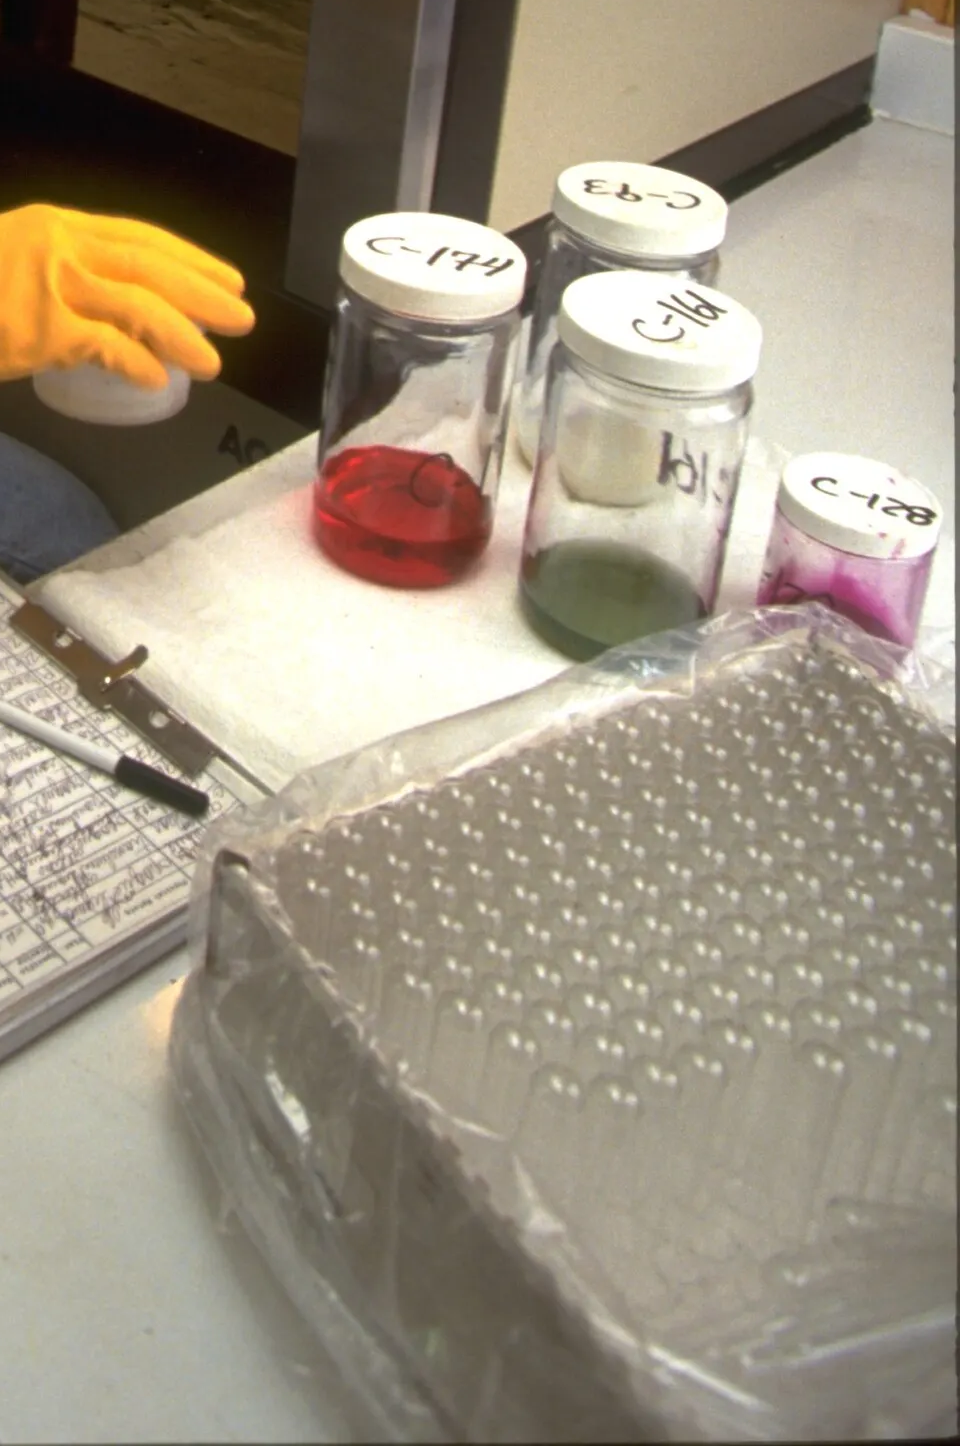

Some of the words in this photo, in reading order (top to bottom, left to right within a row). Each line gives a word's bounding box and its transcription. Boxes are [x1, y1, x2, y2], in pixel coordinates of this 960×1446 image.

[583, 179, 701, 210] C-93
[366, 236, 515, 276] C-174
[632, 290, 729, 343] C-161
[810, 476, 938, 526] C-128
